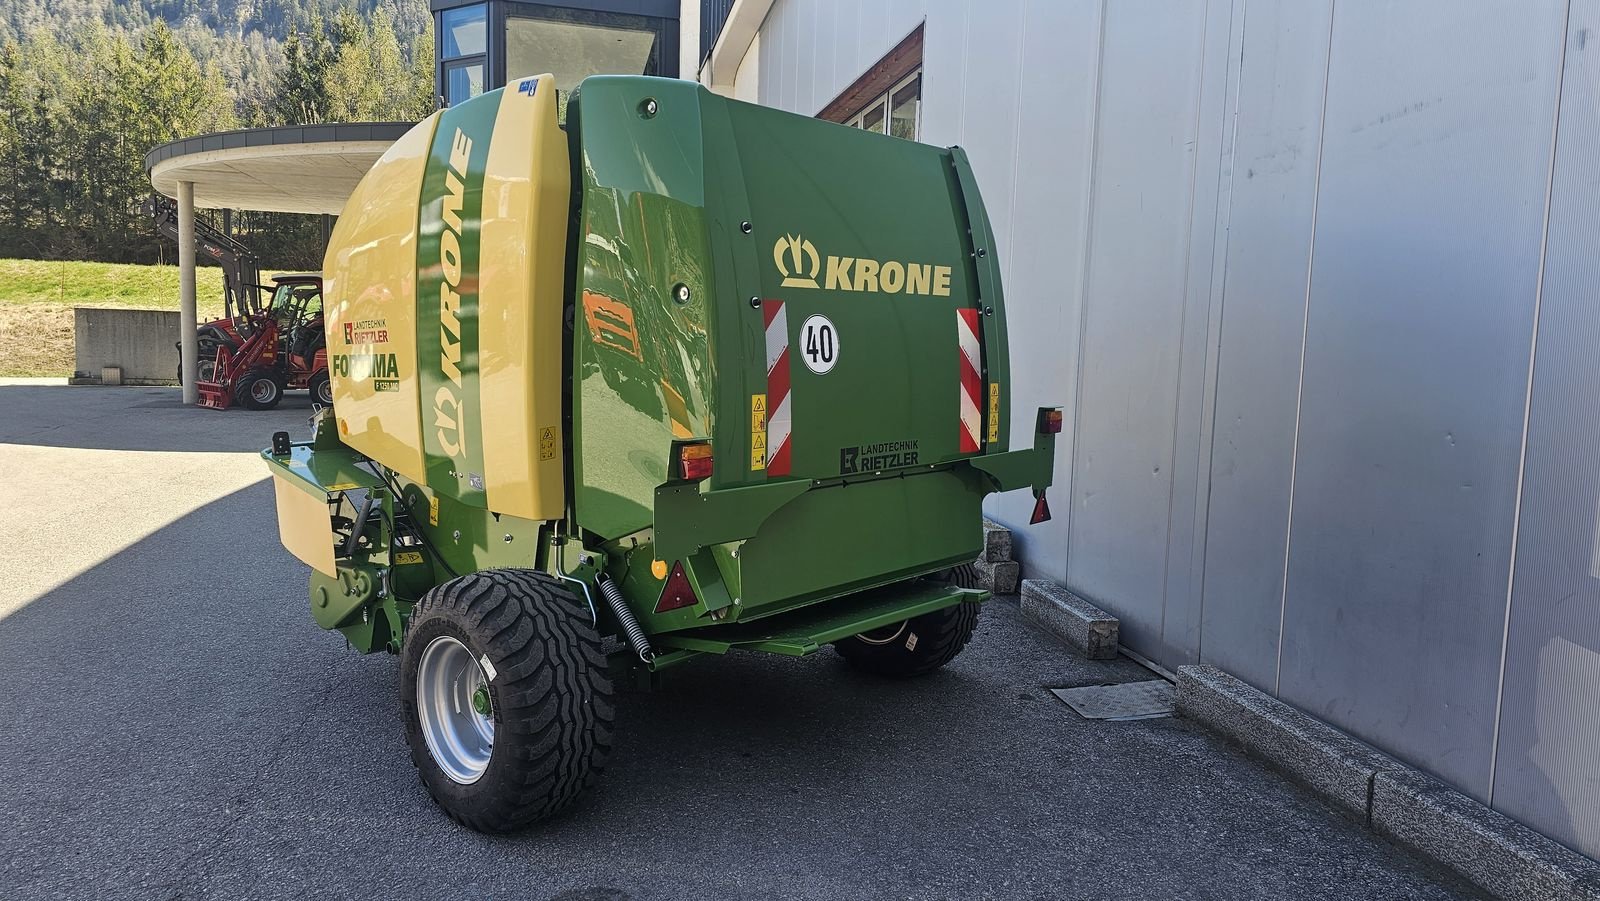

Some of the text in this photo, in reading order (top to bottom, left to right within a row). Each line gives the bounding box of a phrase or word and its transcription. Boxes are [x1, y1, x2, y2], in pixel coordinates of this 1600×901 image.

[440, 126, 473, 389] KRONE
[824, 255, 952, 297] KRONE
[353, 319, 387, 331] LANDTECHNIK
[354, 330, 389, 345] RIETZLER
[806, 325, 833, 363] 40
[333, 353, 399, 378] FORMA
[861, 440, 919, 456] LANDTECHNIK
[861, 451, 919, 472] RIETZLER
